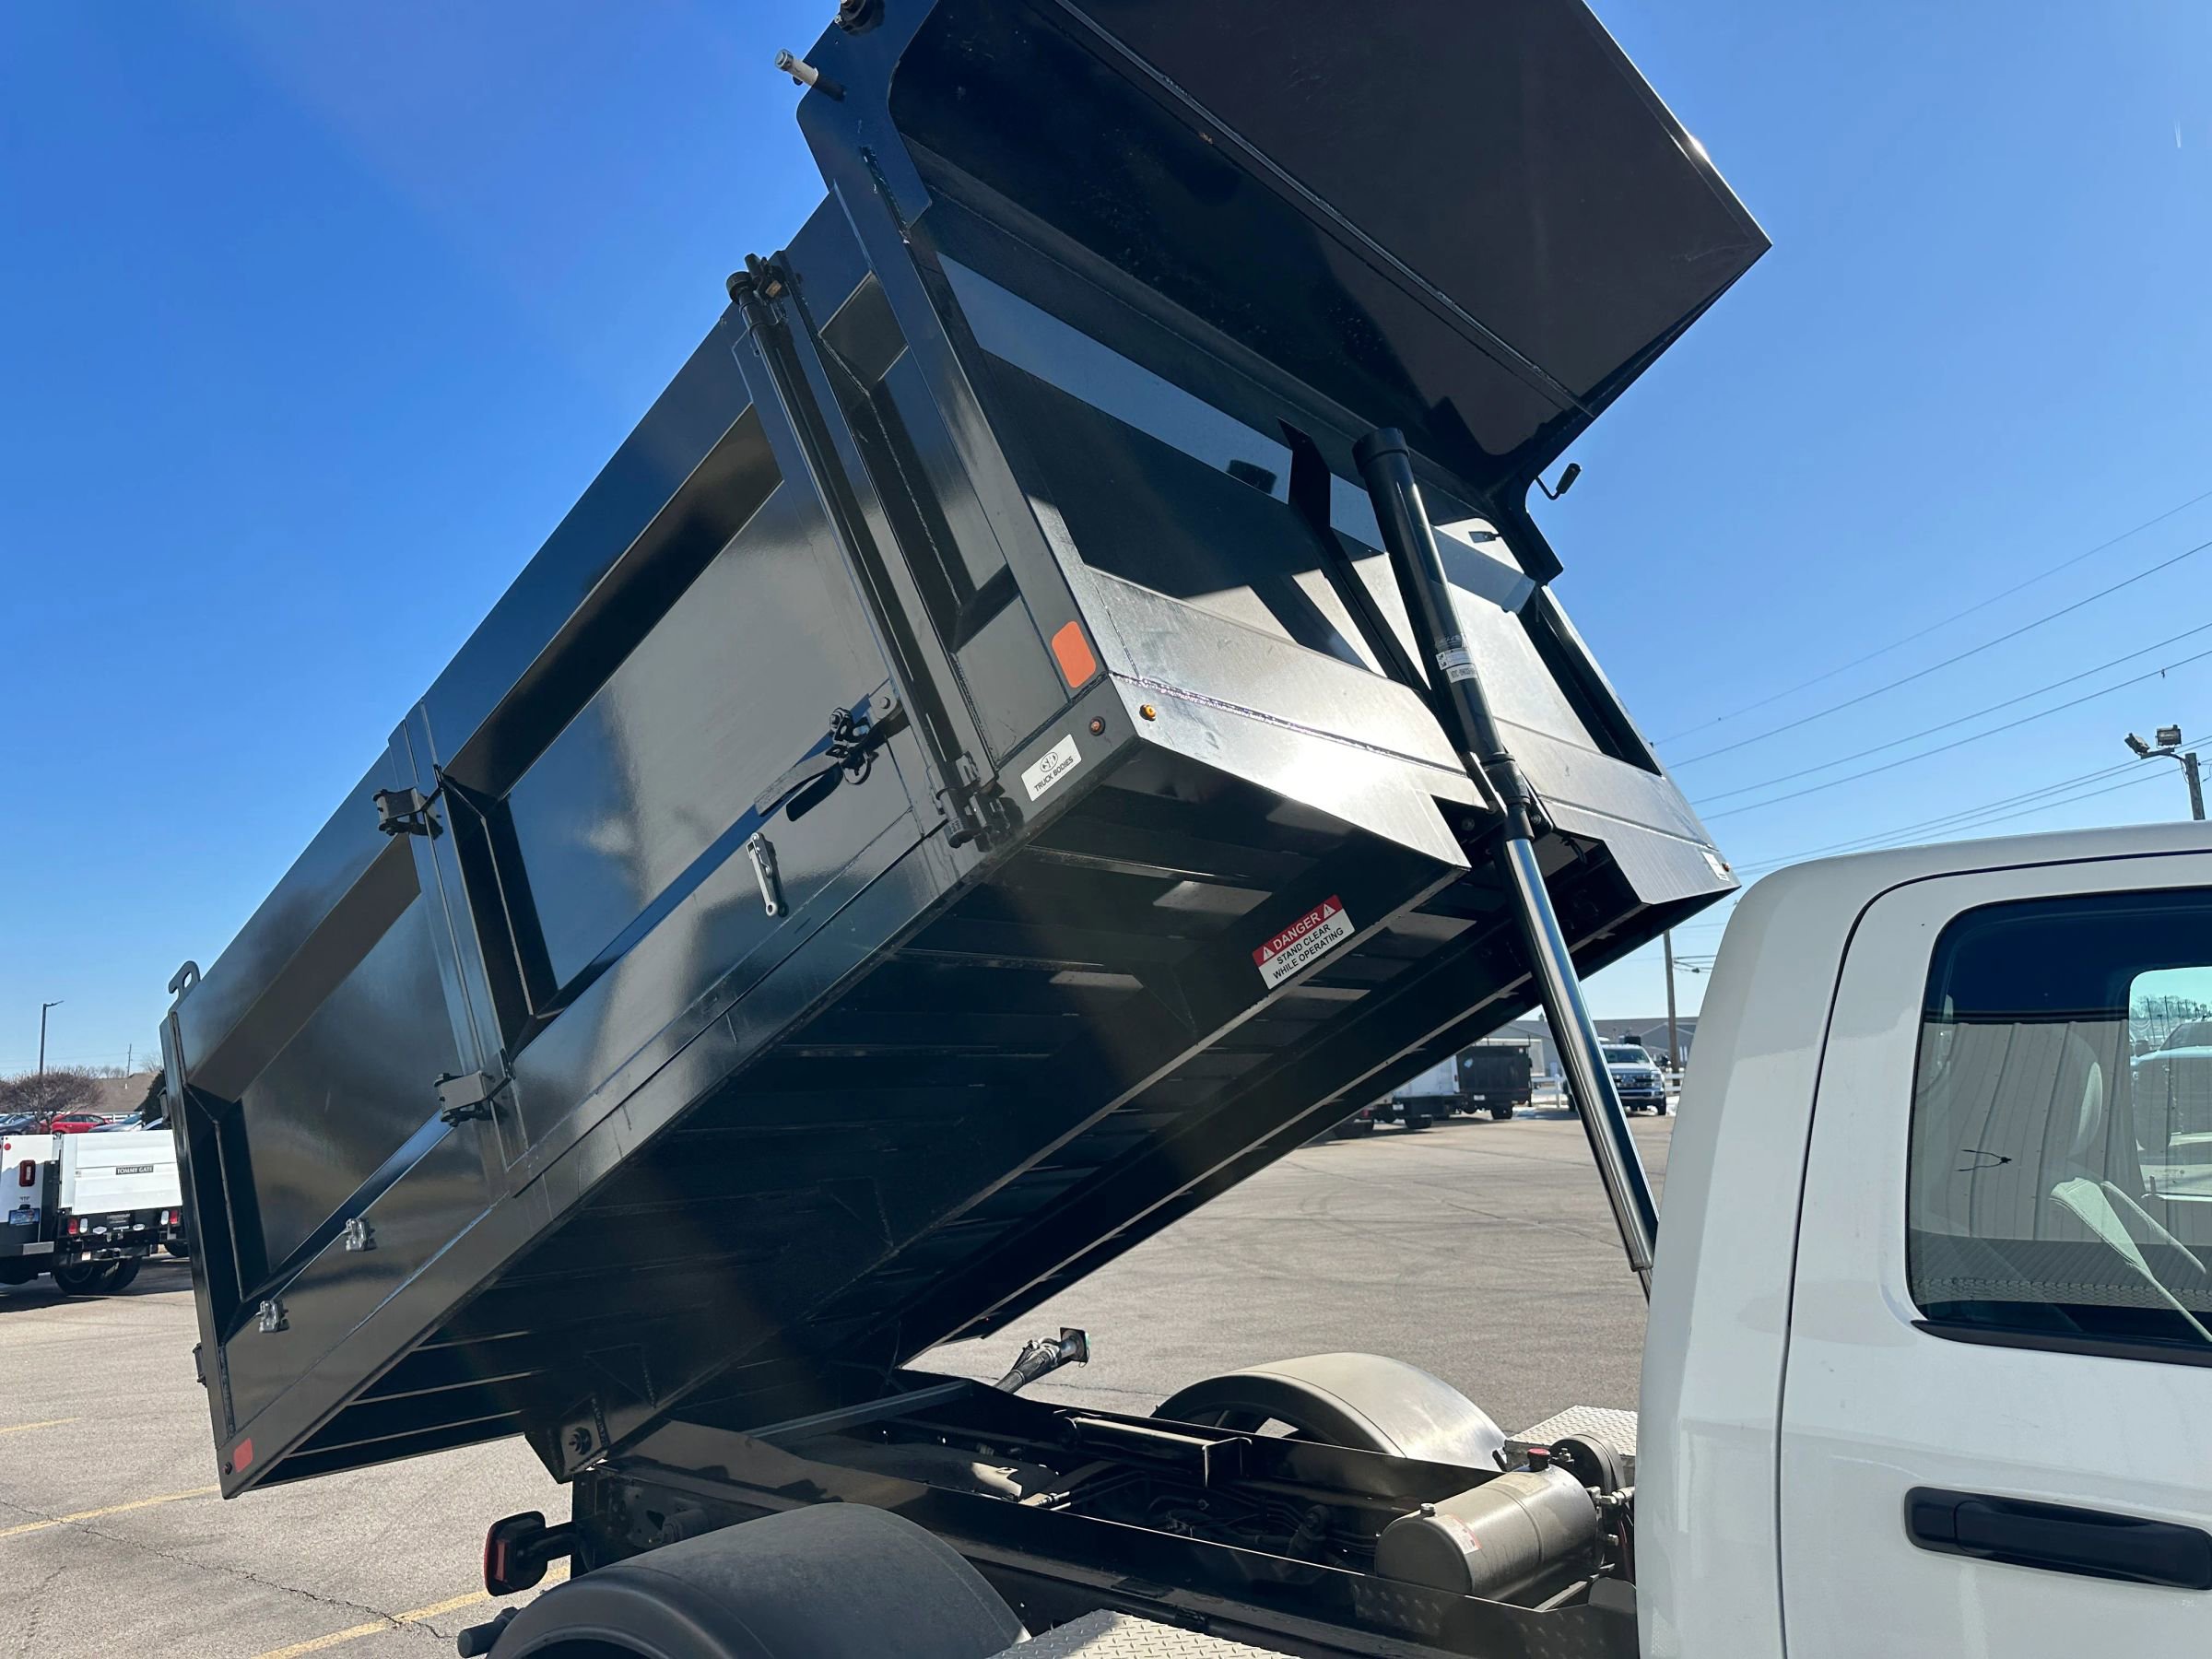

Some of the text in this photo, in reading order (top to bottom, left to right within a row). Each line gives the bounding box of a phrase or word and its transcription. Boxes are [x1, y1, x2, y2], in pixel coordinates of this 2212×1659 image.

[1034, 773, 1053, 792] TRUCK
[1053, 756, 1074, 776] BODIES
[1273, 912, 1322, 950] DANGER
[1277, 924, 1331, 964] STAND CLEAR
[1273, 927, 1344, 979] WHILE OPERATING
